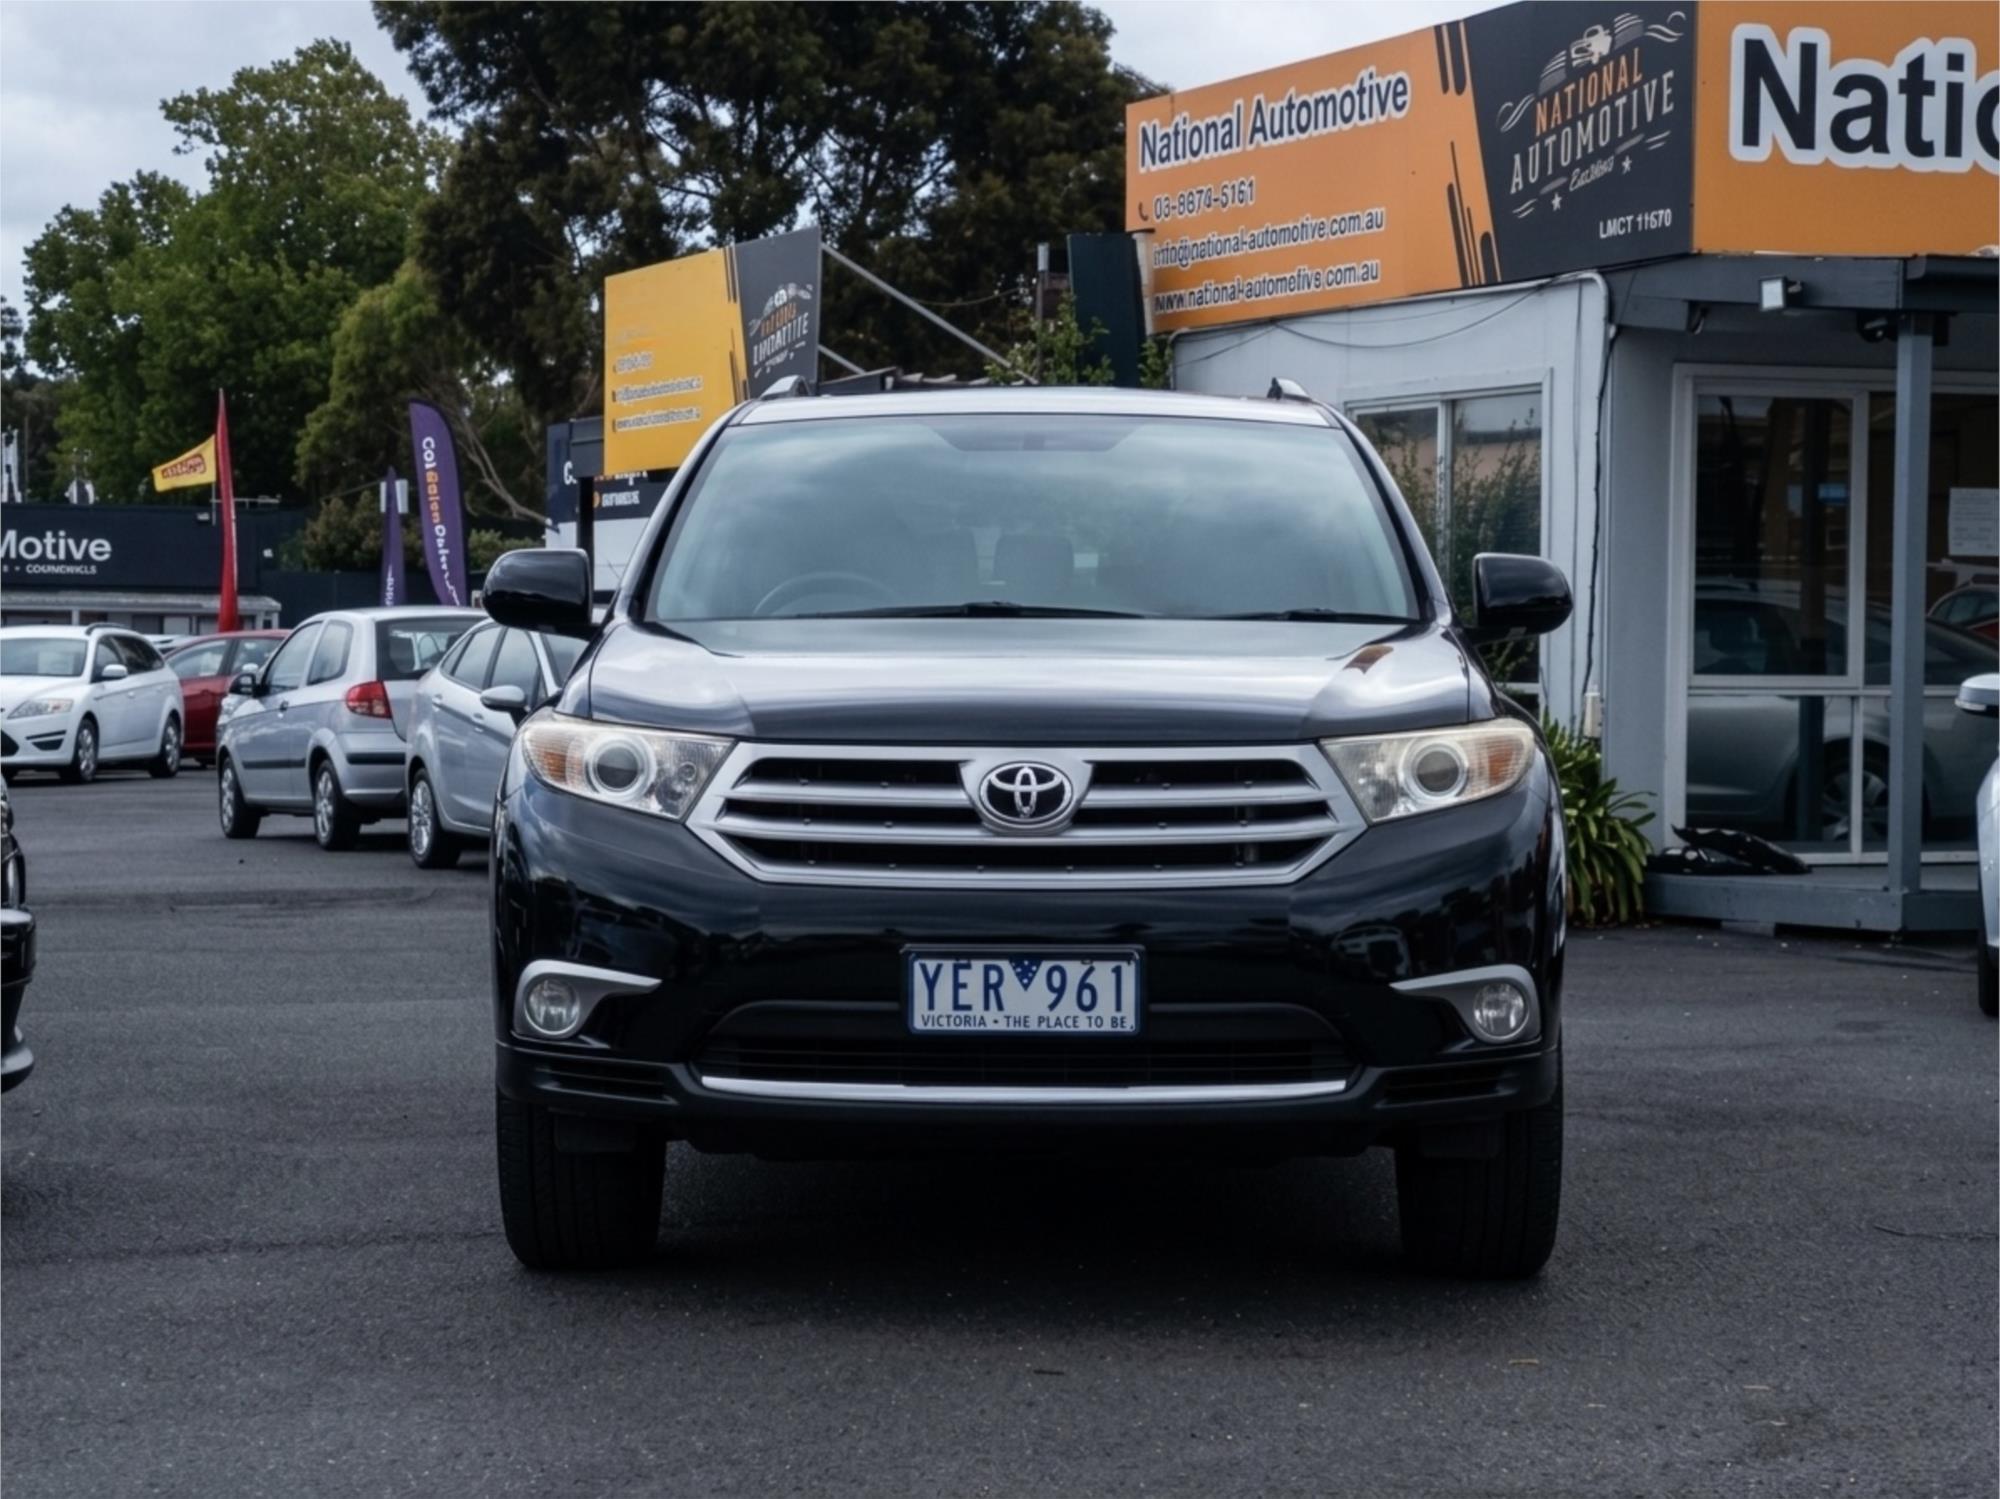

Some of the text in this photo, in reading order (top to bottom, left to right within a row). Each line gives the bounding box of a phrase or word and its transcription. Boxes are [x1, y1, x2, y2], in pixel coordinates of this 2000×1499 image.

[1140, 71, 1409, 169] National Automotive
[1535, 47, 1643, 137] NATIONAL
[1510, 69, 1675, 195] AUTOMOTIVE
[1599, 215, 1634, 239] LMCT
[918, 962, 1123, 1013] YER 961
[921, 1014, 1127, 1029] VICTORIA THE PLACE TO BE
